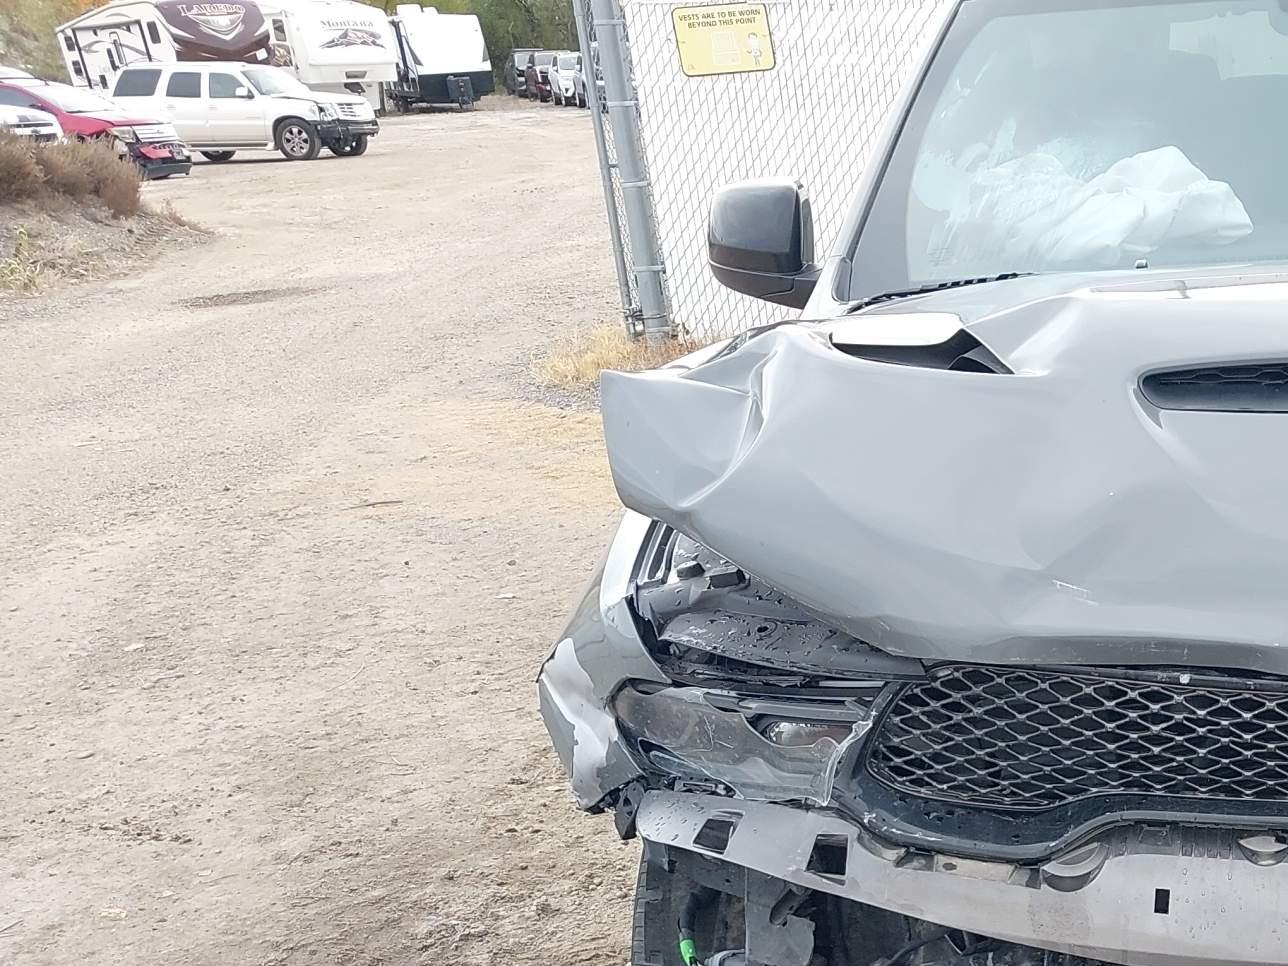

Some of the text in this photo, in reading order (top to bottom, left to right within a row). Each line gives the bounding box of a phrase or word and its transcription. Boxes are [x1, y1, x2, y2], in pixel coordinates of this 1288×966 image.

[678, 13, 700, 21] VESTS
[320, 19, 374, 28] Montana
[687, 17, 756, 29] BEYOND THIS POINT
